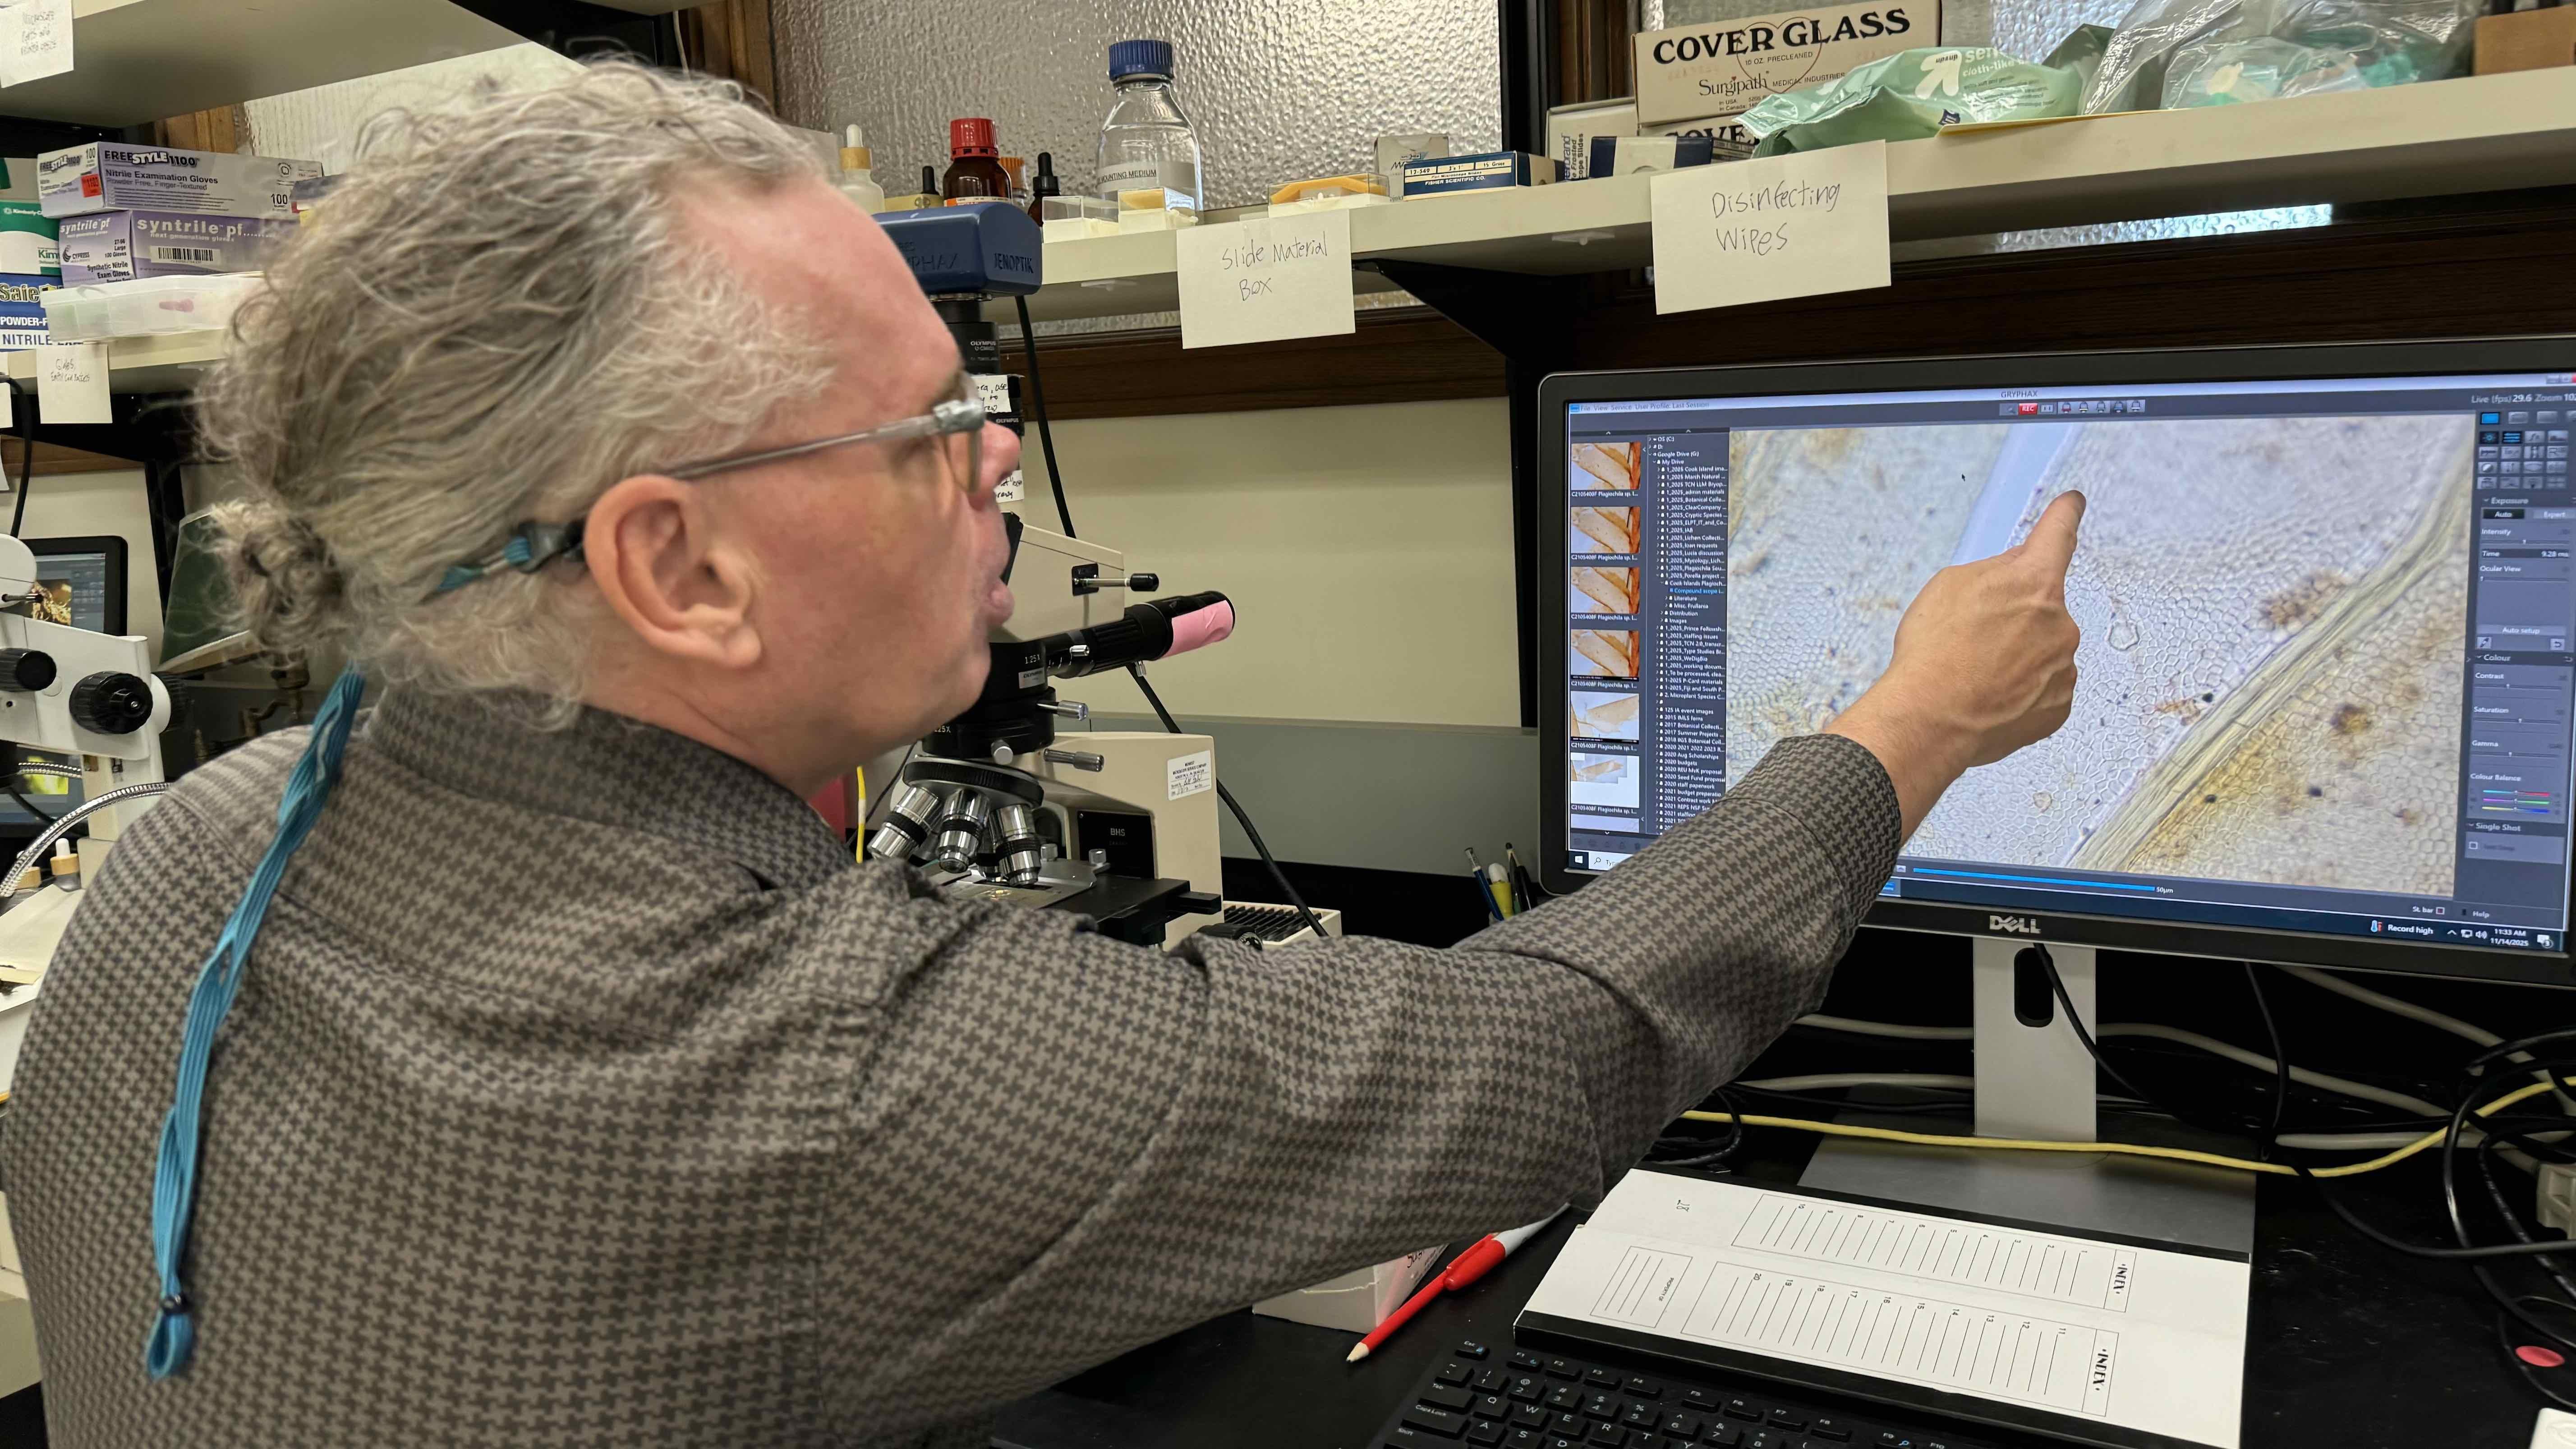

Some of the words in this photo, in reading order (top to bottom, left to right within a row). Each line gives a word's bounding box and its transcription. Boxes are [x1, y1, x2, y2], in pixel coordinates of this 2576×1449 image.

[1653, 27, 1775, 64] COVER
[1782, 8, 1910, 47] GLASS
[1767, 52, 1813, 63] PRECLEANED
[1699, 73, 1767, 97] Surgipath
[1773, 78, 1802, 87] MEDICAL
[1804, 73, 1845, 83] INDUSTRIES
[86, 147, 95, 160] 100
[106, 170, 132, 178] Nitrile
[135, 171, 187, 182] Examination
[189, 175, 217, 184] Gloves
[1128, 169, 1156, 178] MEDIUM
[271, 193, 288, 204] 100
[1712, 180, 1840, 219] Disinfecting
[60, 218, 97, 234] syntrile
[100, 218, 111, 228] pf
[137, 218, 218, 234] syntrile
[227, 223, 243, 238] pf
[1221, 244, 1263, 270] Slide
[1273, 231, 1328, 262] Material
[87, 263, 111, 272] Synthetic
[994, 253, 1034, 274] JENOPTIK
[0, 283, 40, 302] Safe
[3, 334, 52, 345] NITRILE
[2001, 390, 2038, 398] GRYPHAX
[2492, 395, 2511, 404] (fps)
[2512, 394, 2532, 402] 29.6
[2535, 394, 2562, 402] Zoom
[2474, 706, 2509, 714] Saturation
[2494, 773, 2521, 782] Balance
[1110, 828, 1125, 836] BHS
[2476, 822, 2500, 831] Single
[2502, 823, 2521, 832] Shot
[1989, 915, 2042, 934] DELL
[2387, 924, 2414, 933] Record
[2415, 925, 2433, 935] high
[2490, 938, 2529, 946] 11/14/2025
[1753, 1273, 1762, 1281] 20
[2113, 1266, 2128, 1290] INDEX
[1850, 1290, 1858, 1298] 17
[1952, 1308, 1960, 1316] 14
[1986, 1314, 1995, 1323] 13
[2022, 1320, 2030, 1329] 12
[2093, 1353, 2109, 1385] INDEX
